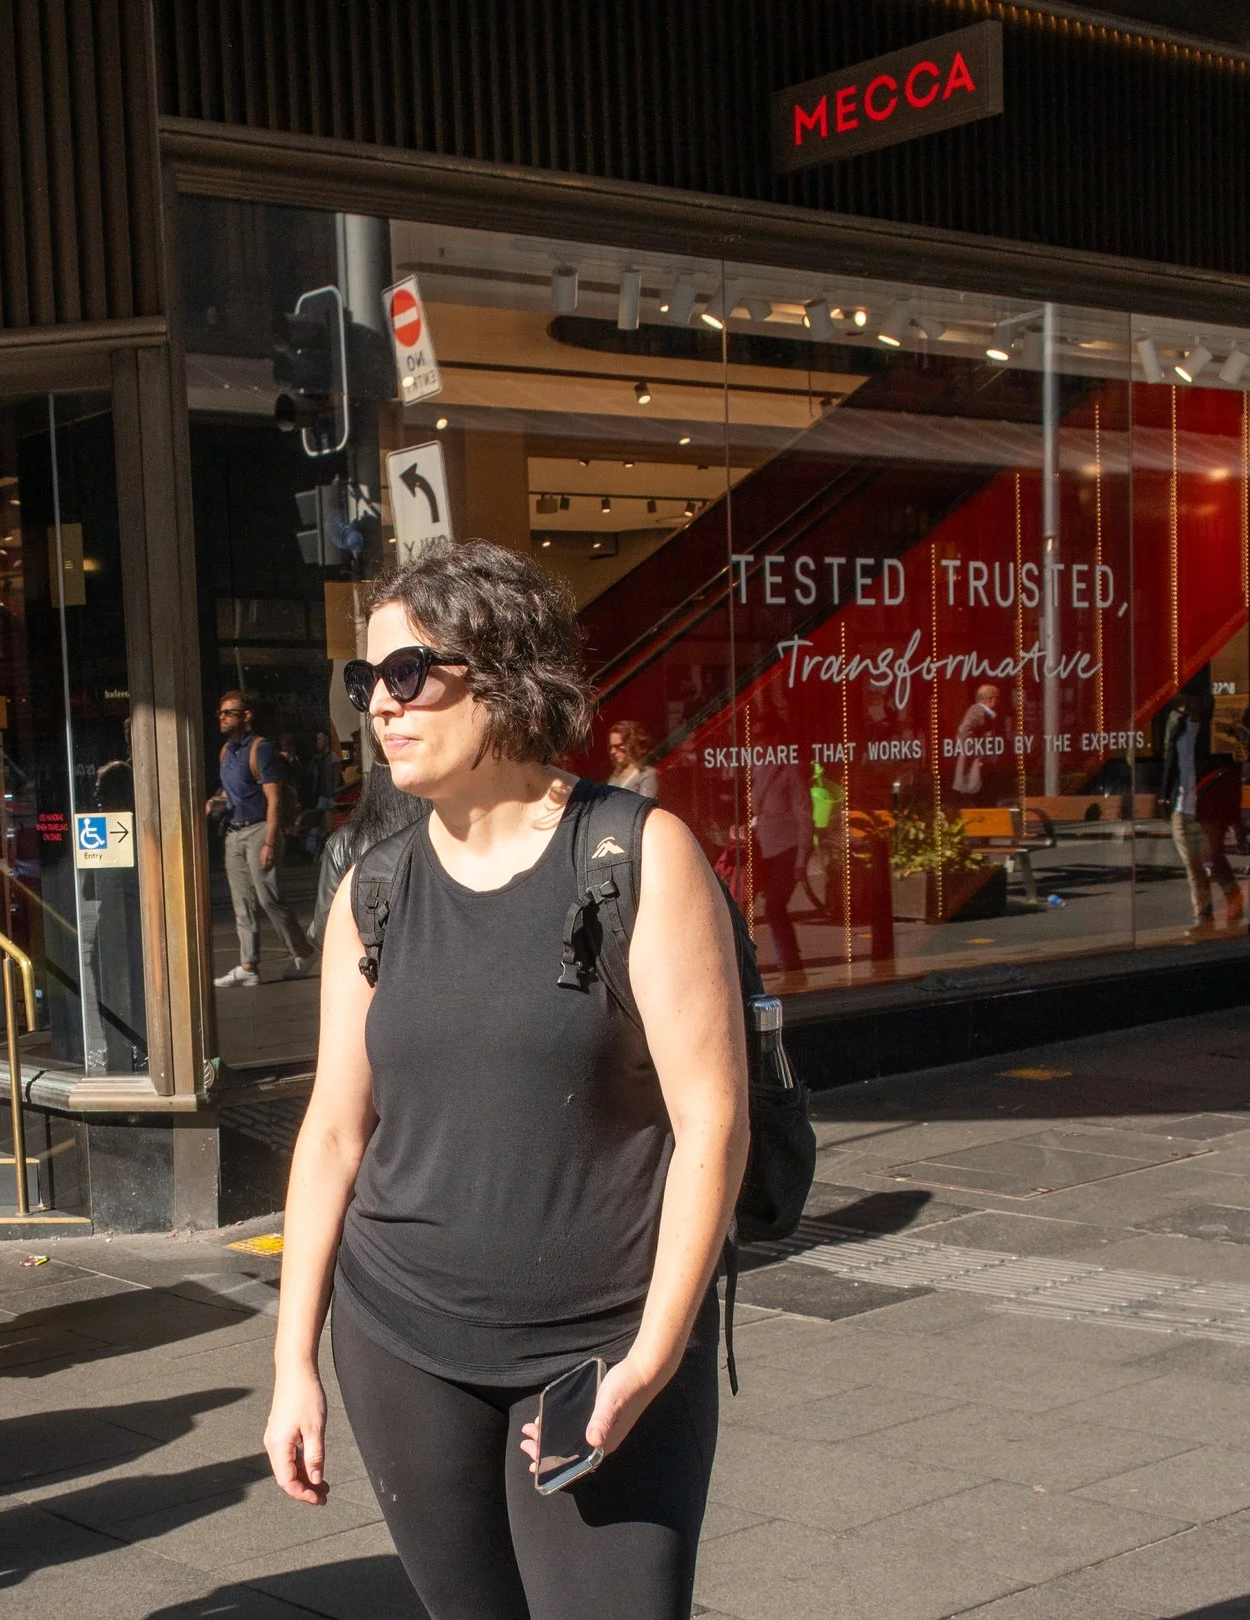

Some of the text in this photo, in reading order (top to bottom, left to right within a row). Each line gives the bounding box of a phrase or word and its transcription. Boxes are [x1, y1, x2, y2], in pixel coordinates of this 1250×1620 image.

[794, 50, 976, 145] MECCA
[730, 554, 1129, 618] TESTED TRUSTED,
[776, 628, 1103, 711] Transformative
[703, 731, 1151, 769] SKINCARE THAT WORKS BACKED BY THE EXPERTS.
[84, 852, 103, 860] Entry
